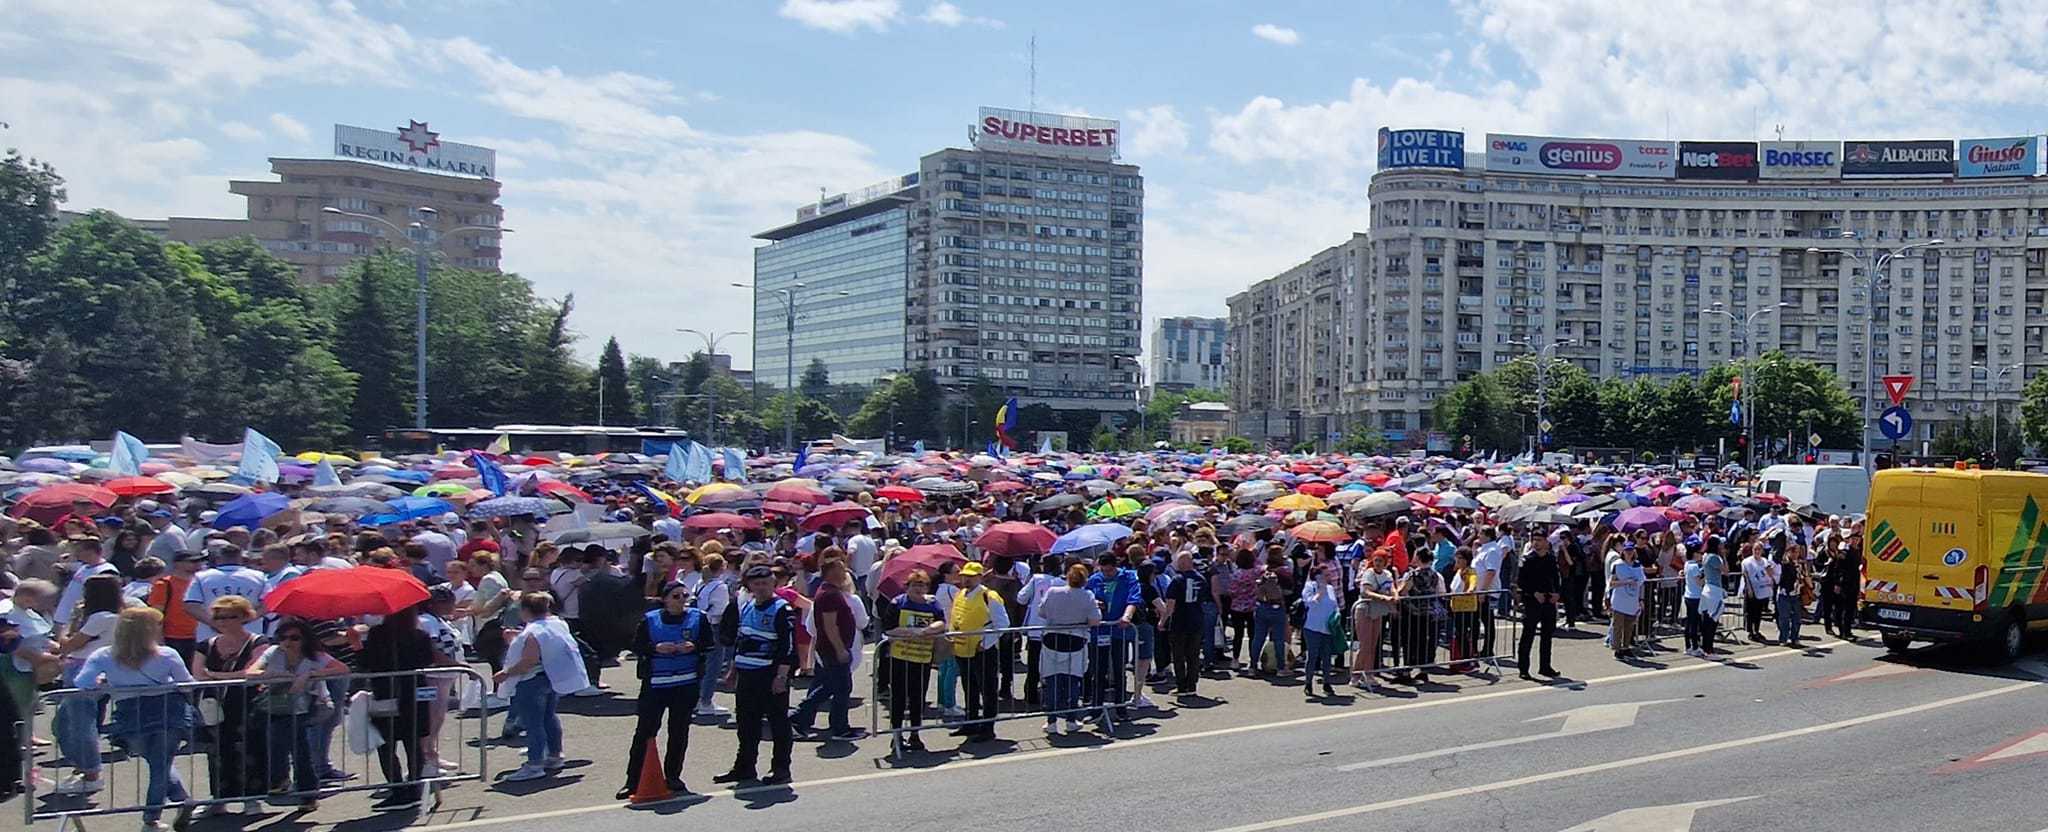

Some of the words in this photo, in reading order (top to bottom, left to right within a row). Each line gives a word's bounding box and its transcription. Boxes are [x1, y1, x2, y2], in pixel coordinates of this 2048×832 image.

[982, 116, 1116, 147] SUPERBET
[1393, 132, 1437, 148] LOVE
[1443, 132, 1463, 148] IT.
[341, 143, 419, 168] REGINA
[427, 157, 490, 177] MARIA
[1393, 149, 1429, 165] LIVE
[1434, 150, 1455, 165] IT.
[1547, 146, 1615, 166] genius
[1683, 152, 1754, 168] NetBet
[1766, 149, 1834, 167] BORSEC
[1881, 147, 1949, 162] ALBACHER
[1968, 144, 2025, 164] Giusto
[1983, 162, 2021, 174] Natura
